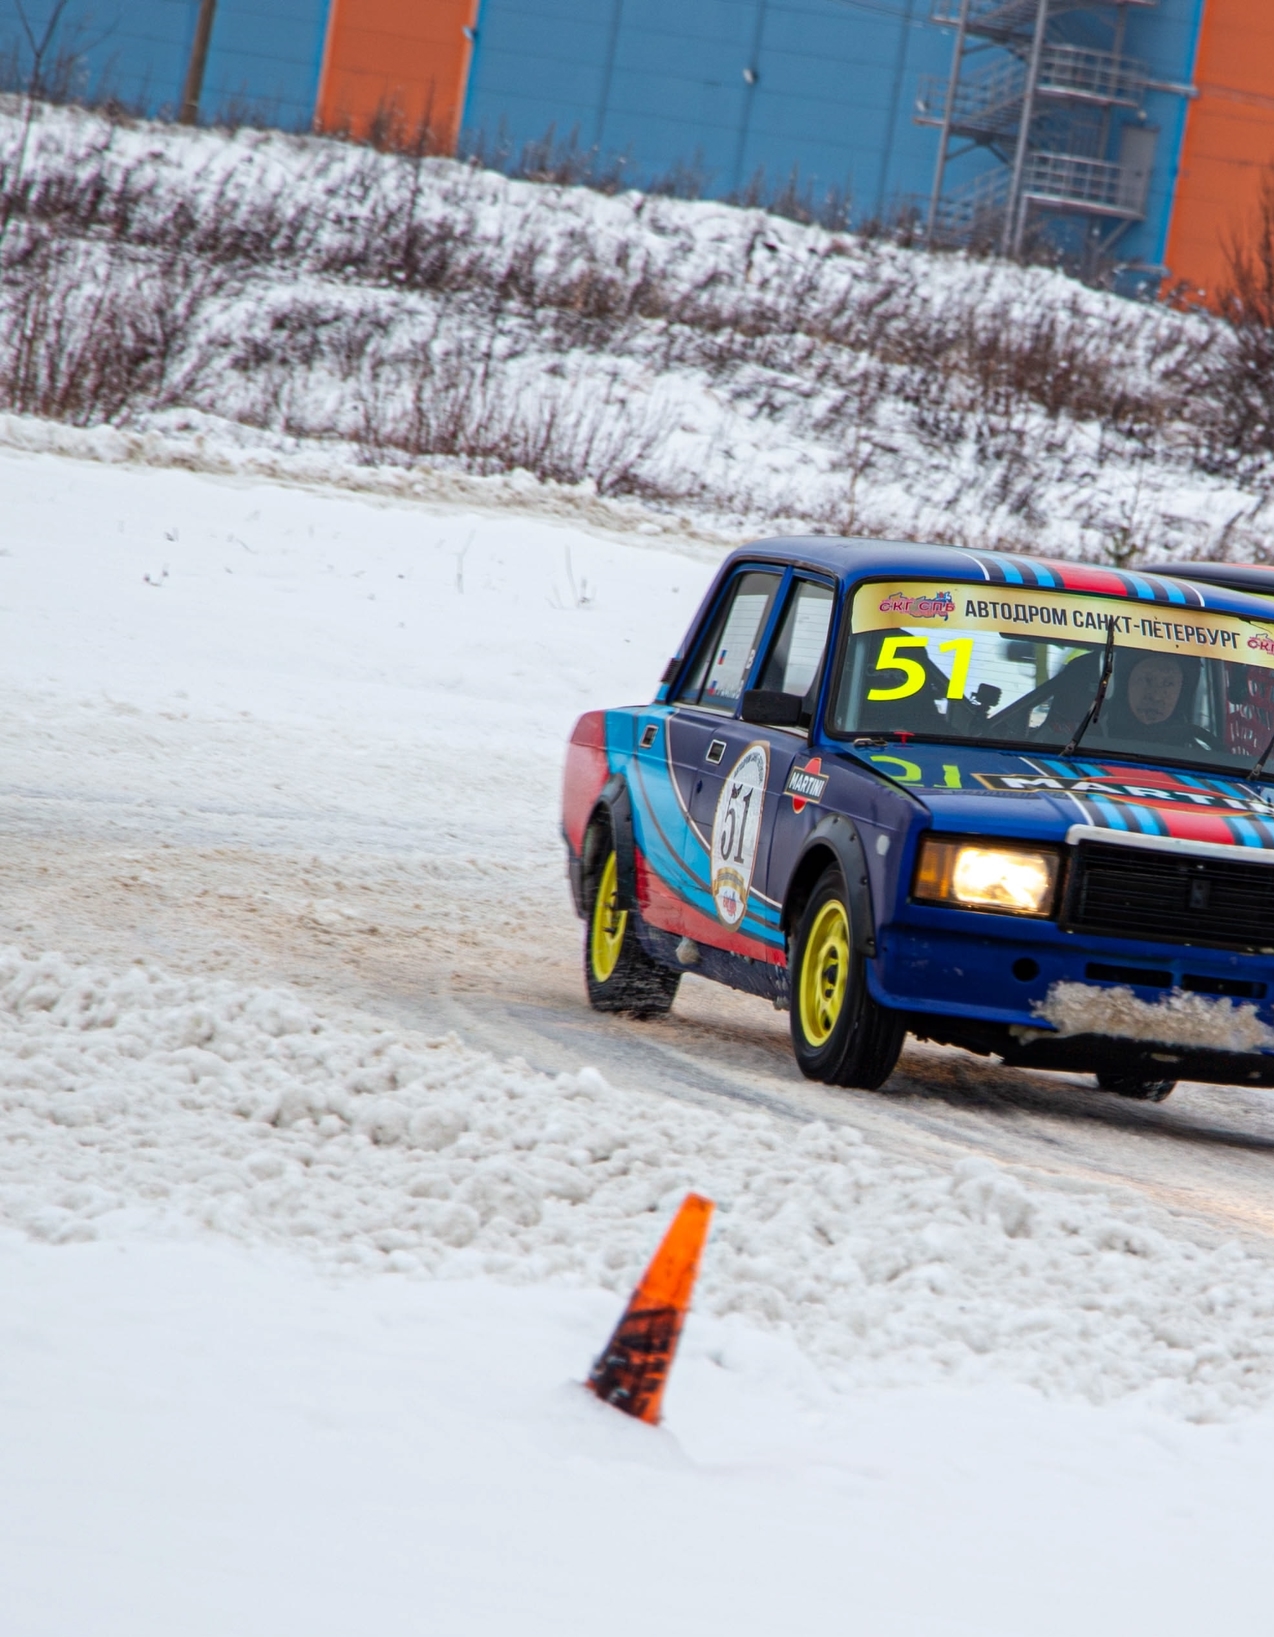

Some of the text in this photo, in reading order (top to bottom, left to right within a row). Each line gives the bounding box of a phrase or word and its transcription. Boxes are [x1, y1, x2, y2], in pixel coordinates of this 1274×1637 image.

[965, 599, 1241, 650] АВТОДРОМ САНКТ-ПЕТЕРБУРГ
[867, 635, 974, 701] 51
[788, 771, 826, 798] MARTINI
[720, 782, 755, 865] 51
